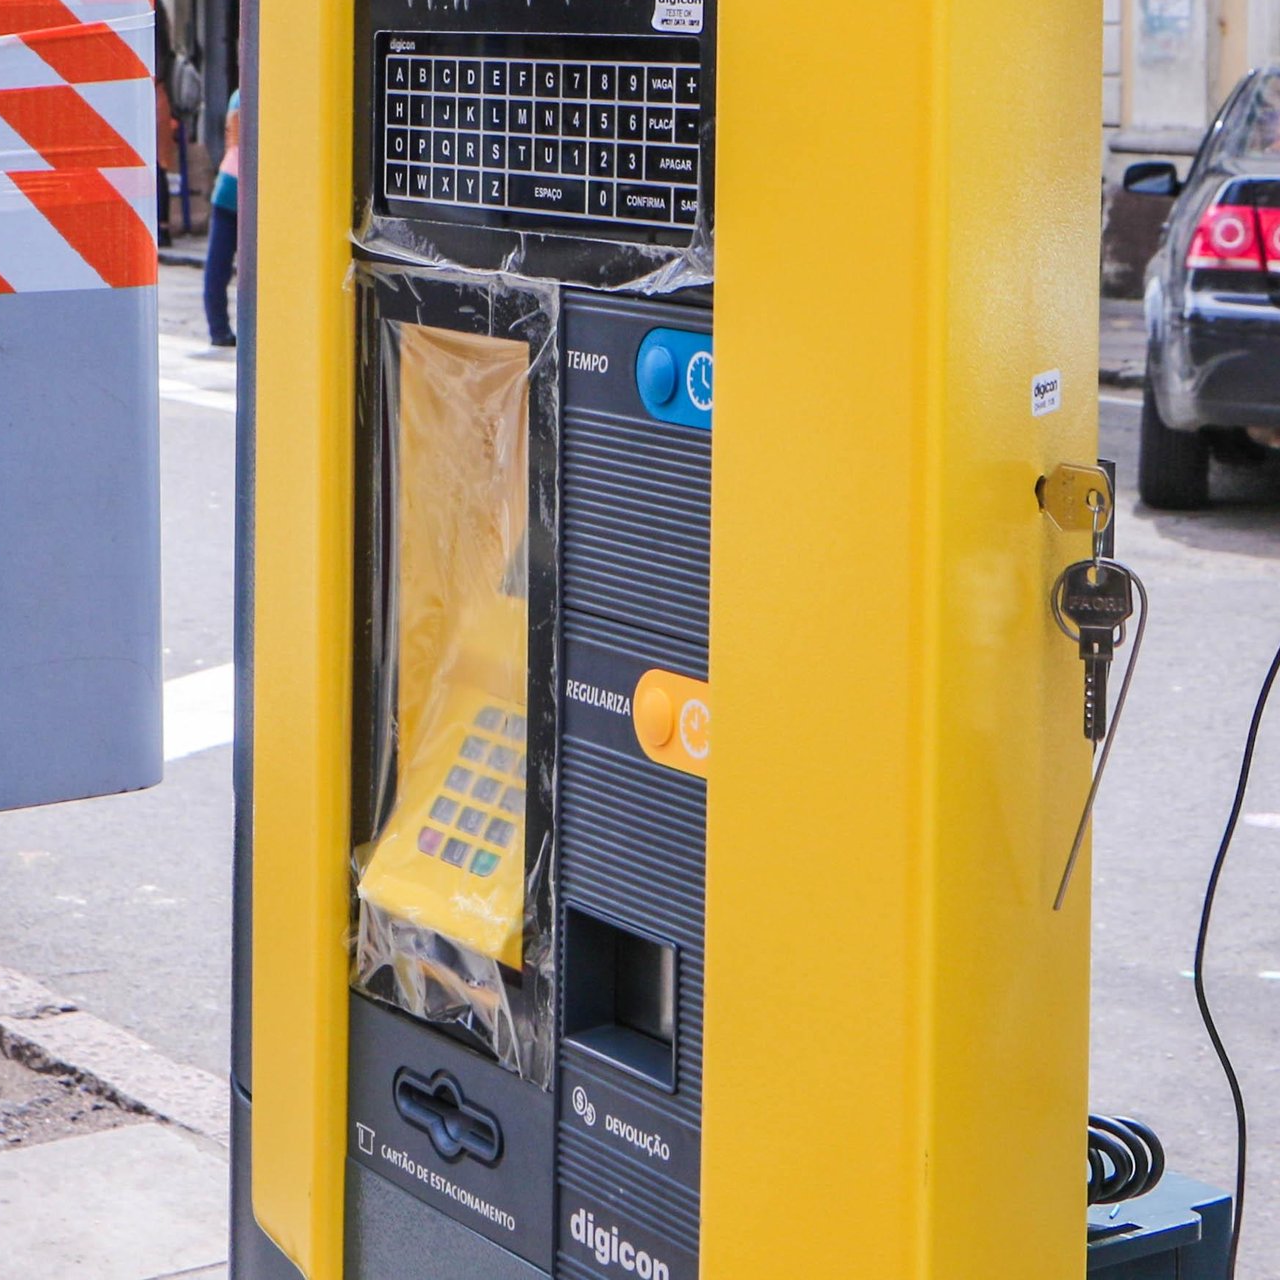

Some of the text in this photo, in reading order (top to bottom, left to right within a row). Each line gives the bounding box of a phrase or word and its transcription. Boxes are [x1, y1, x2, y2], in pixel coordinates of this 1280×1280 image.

[389, 38, 416, 53] digicon
[395, 66, 404, 83] A
[419, 67, 427, 83] B
[442, 68, 451, 84] C
[467, 69, 476, 85] D
[493, 70, 501, 86] E
[519, 71, 527, 87] F
[545, 71, 554, 88] G
[573, 72, 580, 89] 7
[601, 73, 609, 91] 8
[629, 74, 637, 92] 9
[651, 78, 673, 90] VAGA
[396, 102, 403, 118] H
[443, 104, 450, 120] J
[466, 106, 475, 122] K
[492, 107, 500, 123] L
[517, 108, 527, 125] M
[545, 109, 553, 126] N
[572, 111, 580, 128] 4
[600, 112, 608, 129] 5
[629, 114, 637, 131] 6
[648, 118, 673, 130] PLACA
[418, 138, 426, 155] P
[441, 139, 450, 157] Q
[466, 141, 475, 158] R
[492, 143, 500, 160] S
[518, 145, 526, 162] T
[544, 147, 553, 164] U
[600, 150, 608, 168] 2
[628, 152, 636, 170] 3
[659, 157, 692, 171] APAGAR
[394, 172, 403, 188] V
[416, 174, 428, 191] W
[441, 176, 450, 193] X
[466, 178, 475, 195] Y
[491, 180, 500, 197] Z
[534, 187, 562, 200] ESPAÇO
[626, 195, 666, 209] CONFIRMA
[567, 349, 608, 374] TEMPO
[1034, 380, 1058, 399] digicon
[566, 679, 631, 718] REGULARIZA
[605, 1114, 670, 1161] DEVOLUÇÃO
[380, 1143, 516, 1232] CARTÃO DE ESTACIONAMENTO
[570, 1208, 670, 1280] digicon
